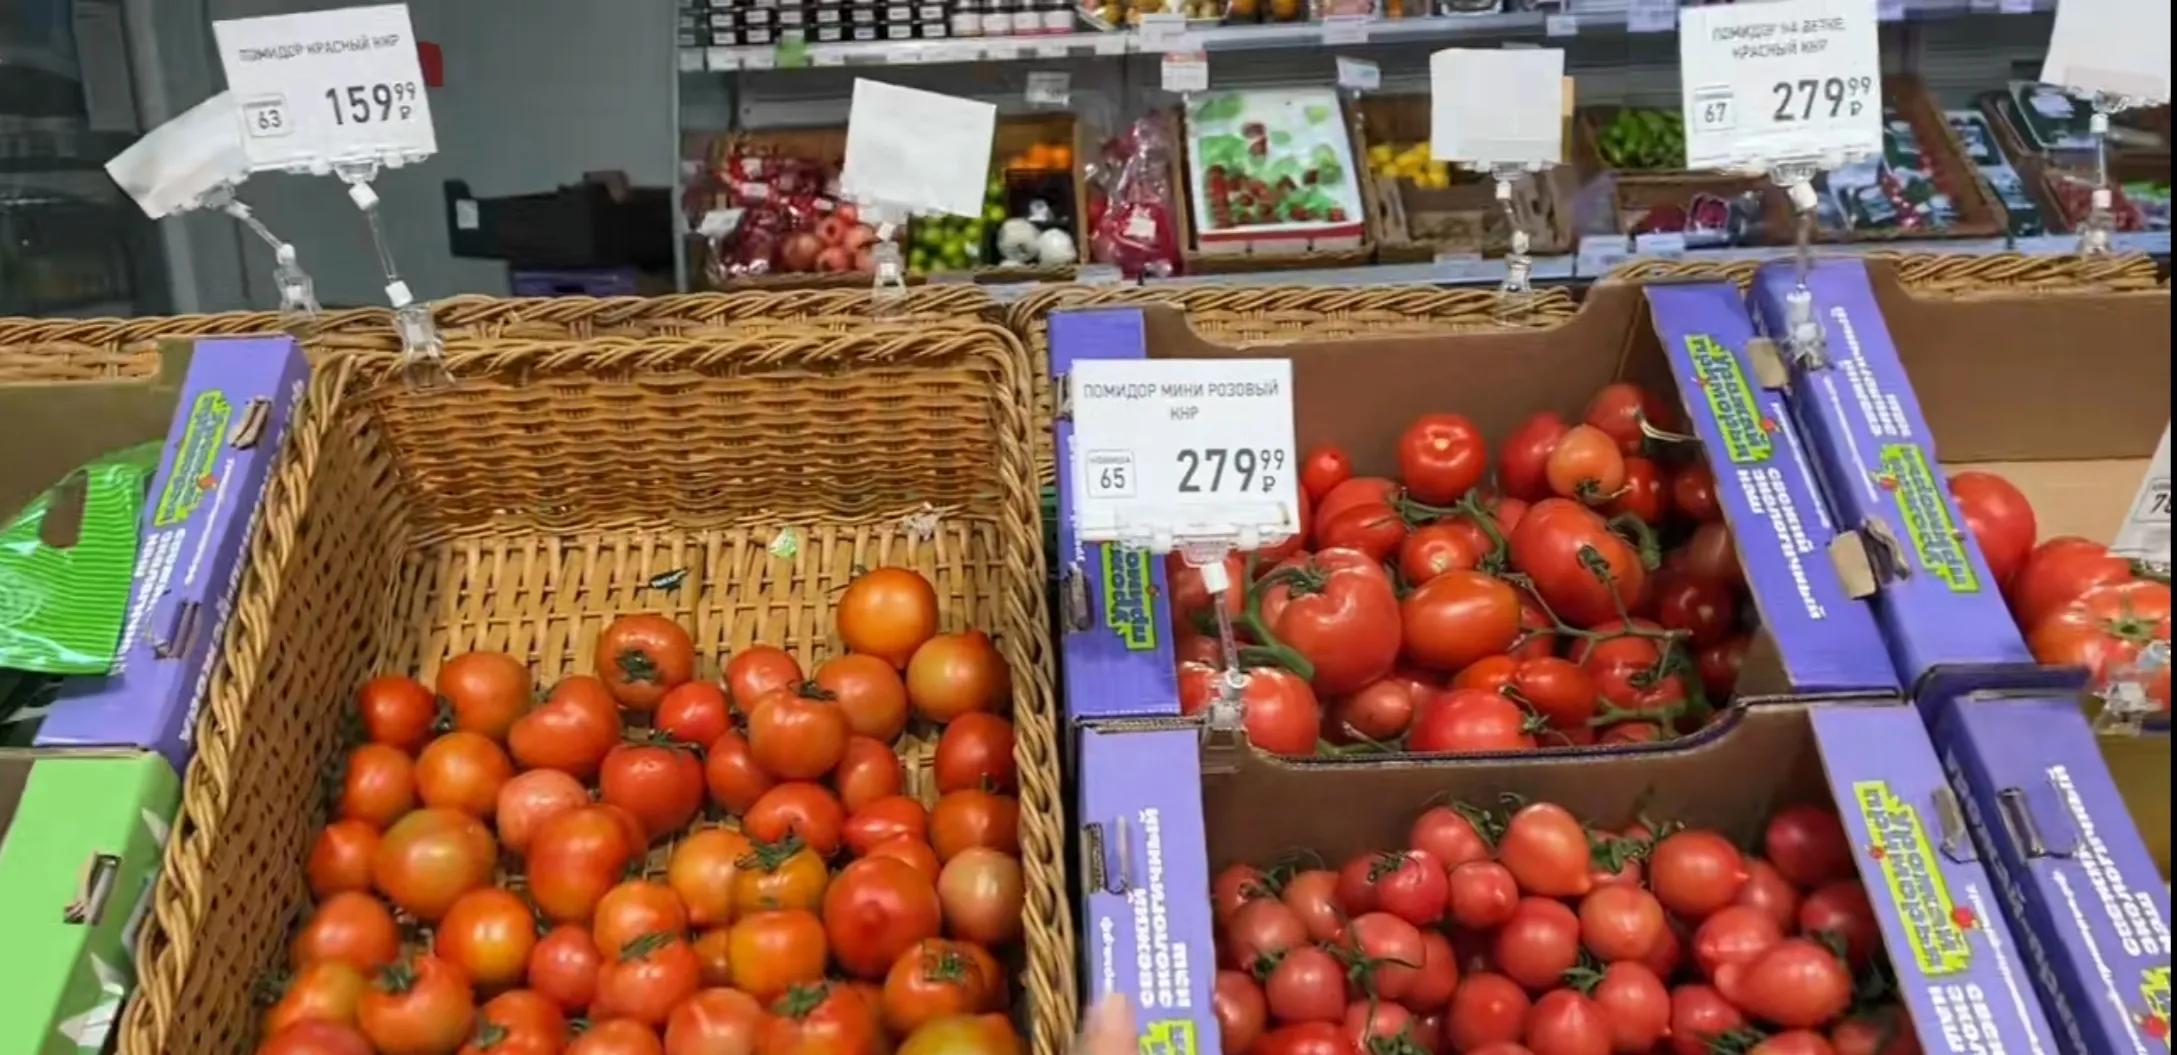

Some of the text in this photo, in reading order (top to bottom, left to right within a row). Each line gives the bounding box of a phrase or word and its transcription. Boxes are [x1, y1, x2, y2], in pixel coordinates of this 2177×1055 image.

[306, 35, 371, 54] КРАСНЫЙ
[325, 83, 393, 126] 159
[1704, 102, 1727, 123] 67
[1772, 77, 1845, 122] 279
[258, 108, 282, 130] 63
[1083, 378, 1279, 400] ПОМИДОР МИНИ РОЗОВЫЙ
[1170, 406, 1200, 421] КНР
[1100, 467, 1126, 489] 65
[1176, 448, 1257, 493] 279
[1260, 449, 1285, 470] 99
[1139, 807, 1173, 1009] экологичный
[1127, 887, 1155, 1009] свежий
[1172, 942, 1192, 1008] наш
